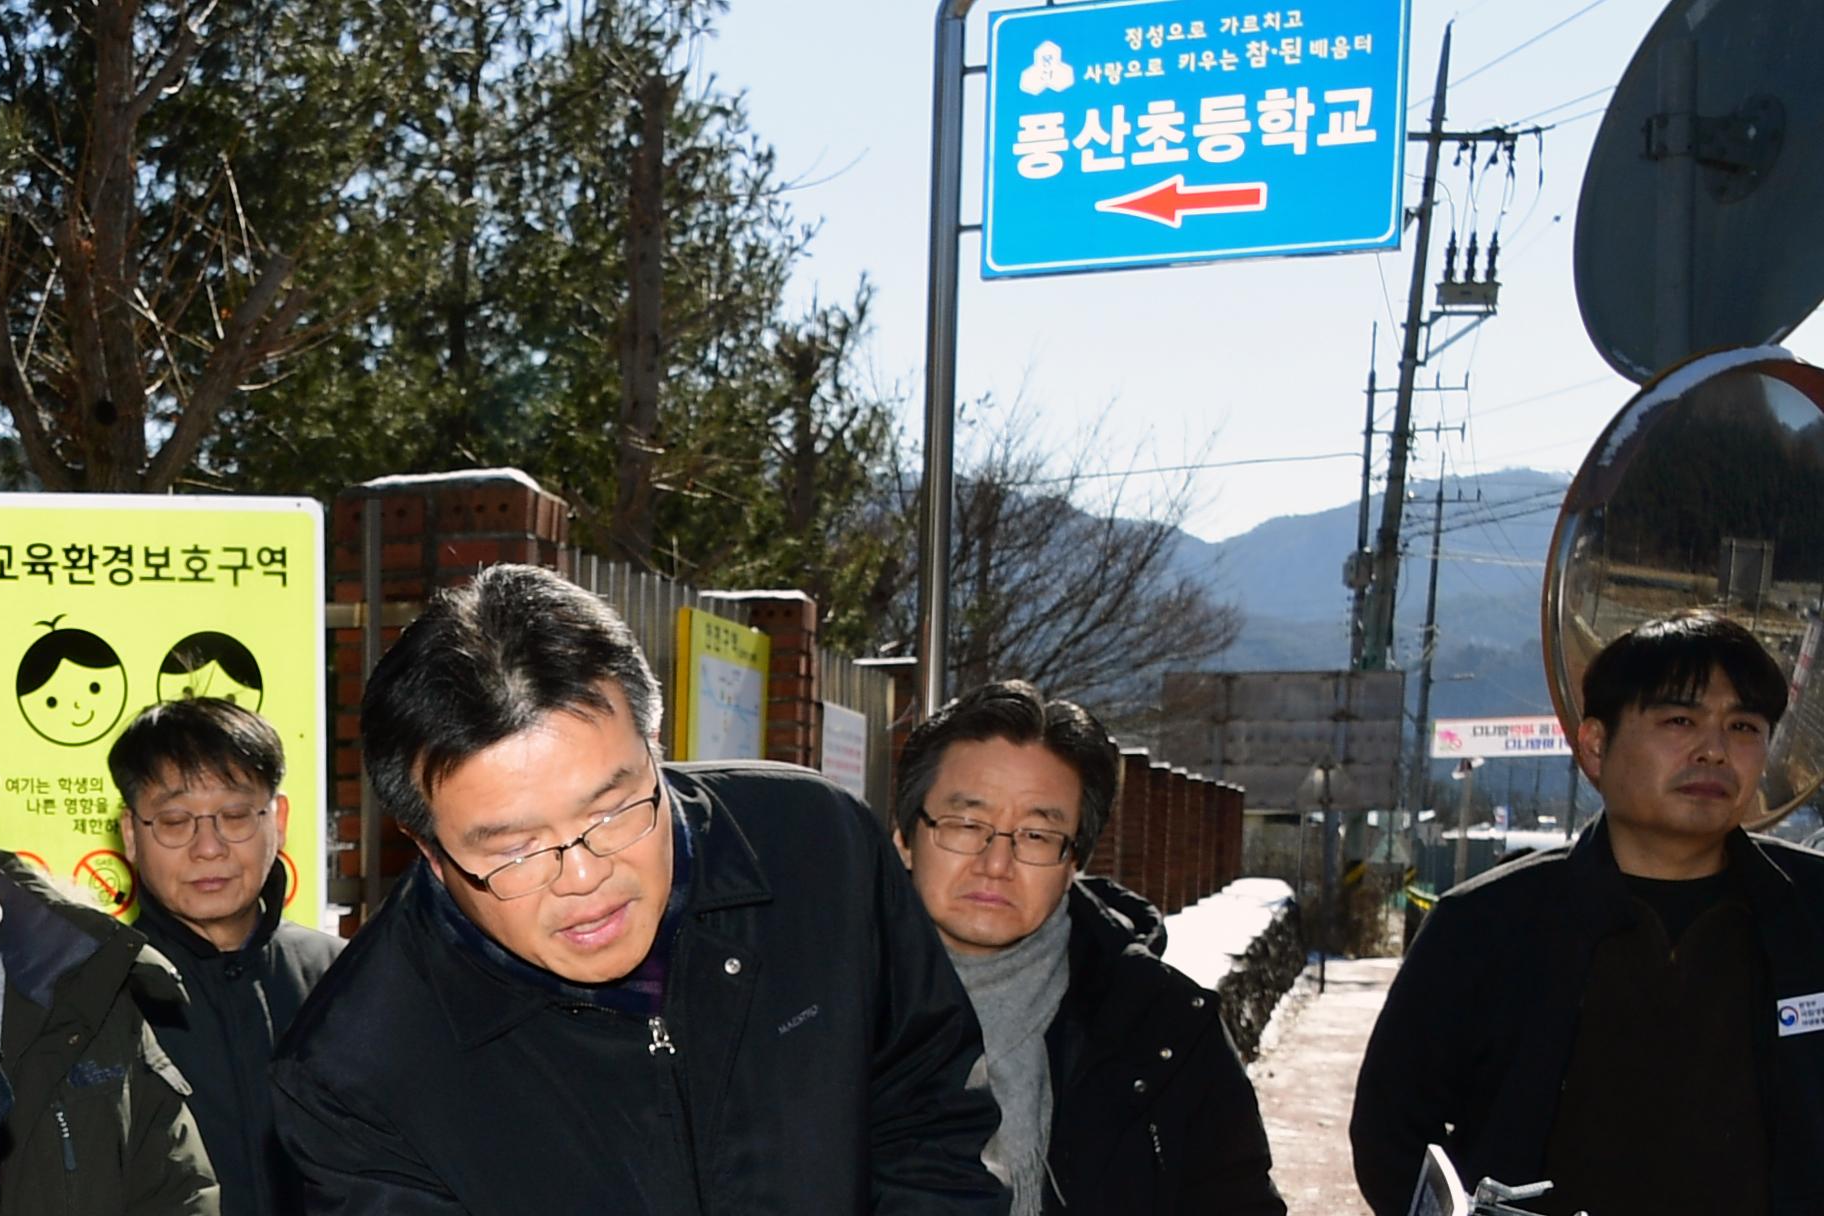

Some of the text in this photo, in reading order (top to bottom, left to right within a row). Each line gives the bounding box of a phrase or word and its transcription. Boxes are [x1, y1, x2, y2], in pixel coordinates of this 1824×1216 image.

[1125, 10, 1304, 50] 정성으로 가르치고
[1084, 58, 1166, 85] 사랑으로
[1178, 49, 1239, 72] 키우는
[1309, 34, 1372, 60] 배움터
[1012, 87, 1377, 180] 풍산초등학교
[5, 776, 104, 794] 여기는 학생의
[64, 797, 110, 815] 영향을
